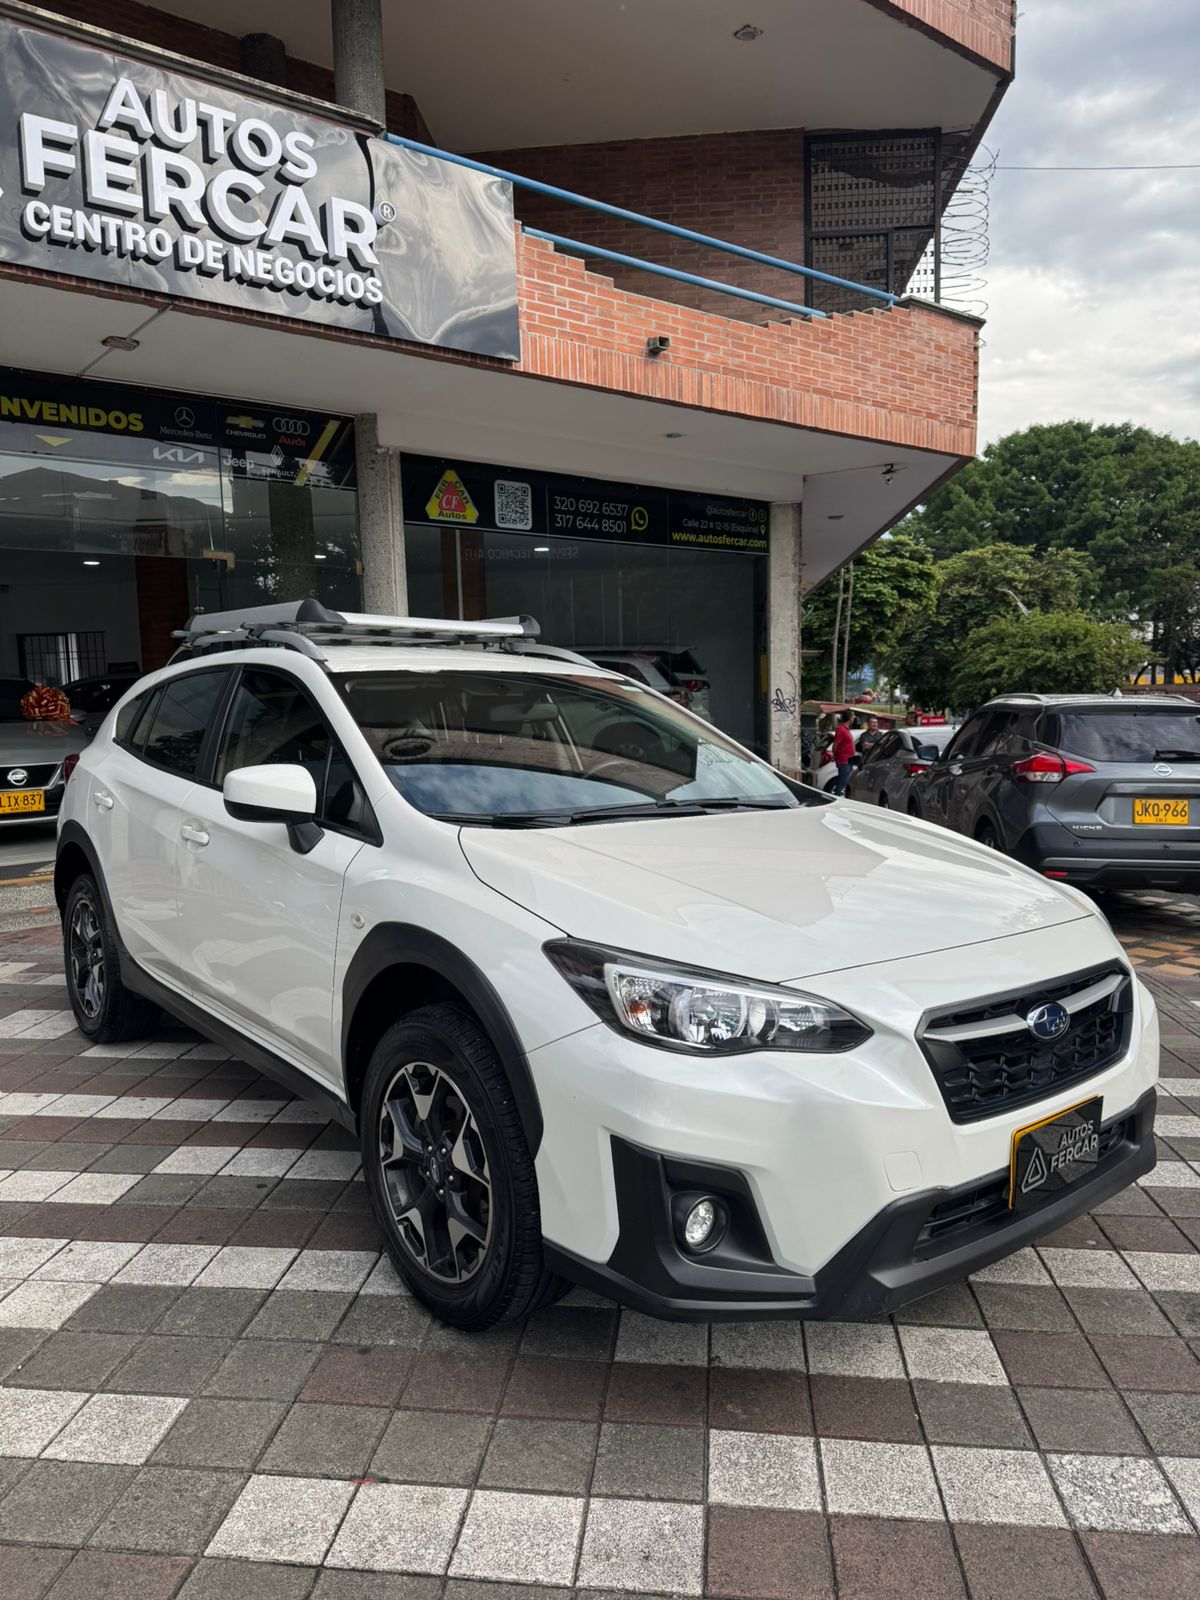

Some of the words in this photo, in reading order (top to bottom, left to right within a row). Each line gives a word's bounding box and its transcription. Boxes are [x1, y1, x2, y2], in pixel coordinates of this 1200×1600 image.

[99, 78, 317, 184] AUTOS
[19, 112, 381, 270] FERCAR
[24, 200, 173, 262] CENTRO
[178, 234, 226, 276] DE
[229, 248, 384, 303] NEGOCIOS
[159, 425, 213, 440] Mercedes-Benz
[225, 429, 267, 439] CHEVROLET
[278, 435, 306, 447] Audi
[222, 456, 255, 470] Jeep
[434, 479, 449, 499] FER
[455, 480, 470, 504] CAR
[441, 494, 460, 510] CF
[554, 496, 576, 511] 320
[578, 498, 600, 513] 692
[602, 502, 629, 517] 6537
[438, 511, 468, 520] Autos
[554, 514, 574, 528] 317
[576, 516, 600, 531] 644
[601, 519, 627, 534] 8501
[682, 518, 700, 528] Calle
[700, 520, 709, 529] 22
[730, 523, 760, 534] (Esquina)
[671, 531, 767, 549] www.autosfercar.com
[1059, 1120, 1094, 1150] AUTOS
[1051, 1133, 1099, 1173] FERCAR
